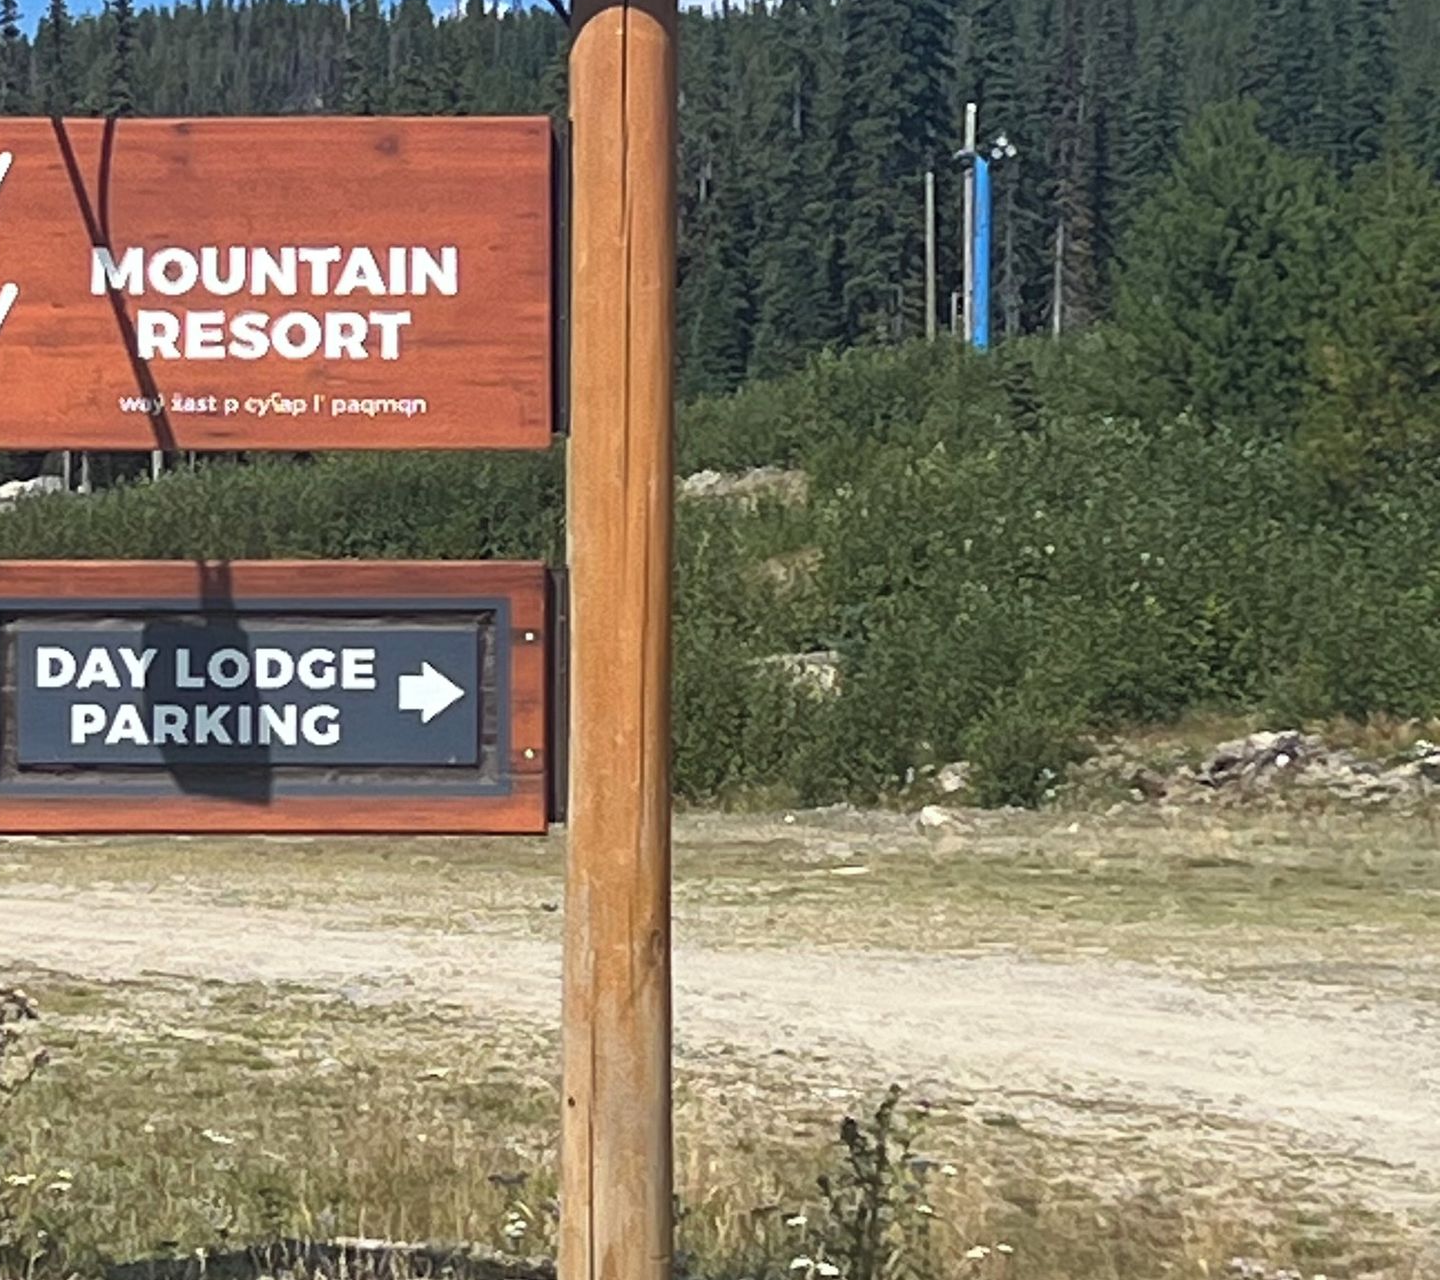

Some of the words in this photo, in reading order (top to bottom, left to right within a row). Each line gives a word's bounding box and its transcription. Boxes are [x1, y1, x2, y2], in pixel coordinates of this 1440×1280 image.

[89, 244, 460, 297] MOUNTAIN
[135, 308, 413, 361] RESORT
[223, 398, 241, 417] p
[35, 646, 160, 690] DAY
[175, 647, 377, 690] LODGE
[69, 703, 341, 747] PARKING
